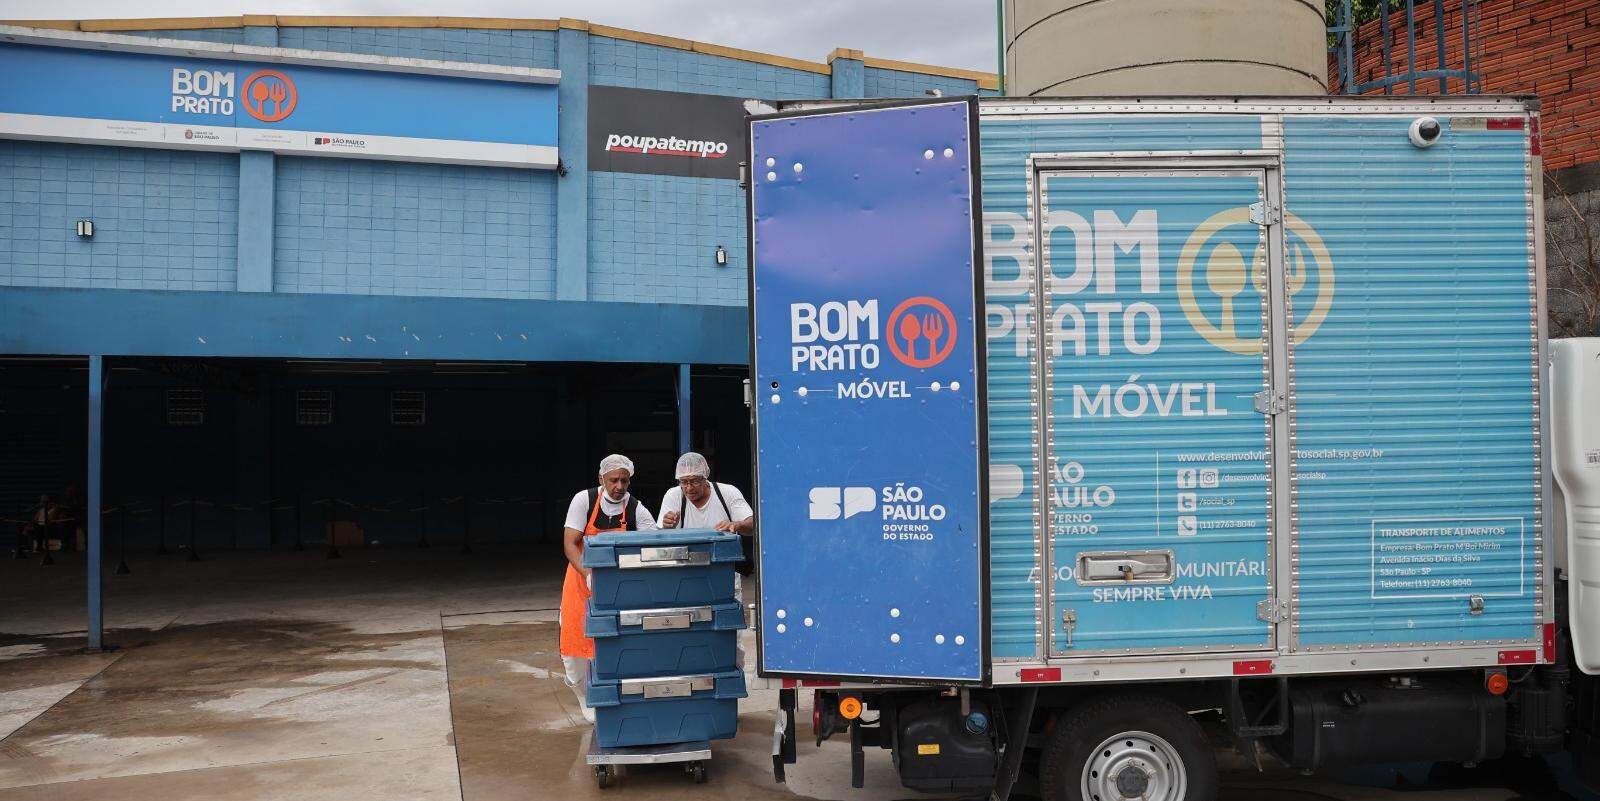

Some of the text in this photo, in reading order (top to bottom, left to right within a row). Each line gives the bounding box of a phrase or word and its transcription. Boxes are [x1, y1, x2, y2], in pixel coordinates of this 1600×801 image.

[172, 68, 235, 97] BOM
[172, 95, 234, 116] PRATO
[605, 133, 728, 158] poupatempo
[790, 299, 879, 343] BOM
[791, 343, 880, 372] PRATO
[837, 378, 911, 400] MÓVEL
[1072, 374, 1228, 418] MÓVEL
[808, 482, 923, 520] SP SÃO
[1054, 485, 1116, 508] AULO
[882, 504, 946, 521] PAULO
[1055, 513, 1093, 523] ERNO
[882, 524, 929, 532] GOVERNO
[883, 533, 934, 541] DO ESTADO
[1380, 527, 1506, 537] TRANSPORTE DE ALIMENTOS
[1415, 543, 1433, 551] Bom
[1434, 543, 1455, 551] Prato
[1176, 557, 1266, 578] MUNITÁRI
[1380, 556, 1410, 564] Avenida
[1435, 555, 1452, 563] Dias
[1453, 555, 1462, 563] da
[1463, 554, 1481, 563] Silva
[1421, 567, 1432, 576] SP
[1093, 585, 1214, 603] SEMPRE VIVA
